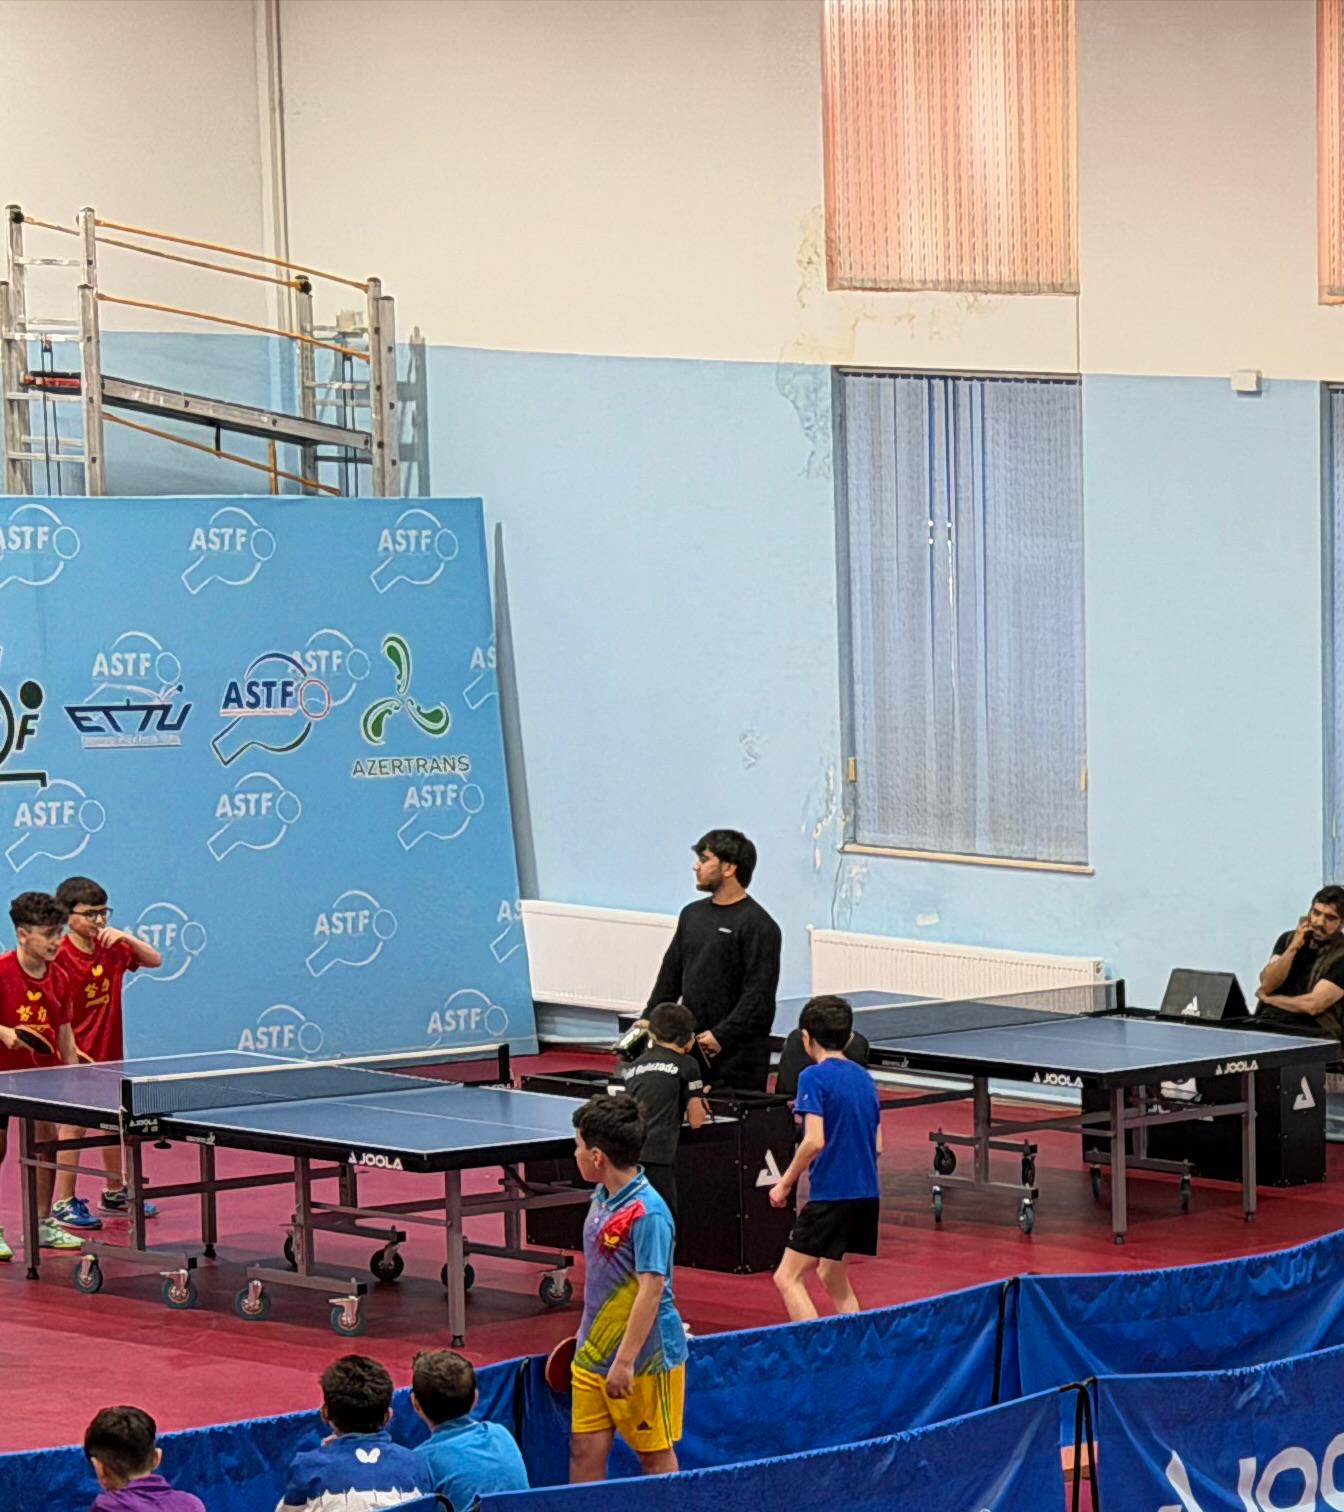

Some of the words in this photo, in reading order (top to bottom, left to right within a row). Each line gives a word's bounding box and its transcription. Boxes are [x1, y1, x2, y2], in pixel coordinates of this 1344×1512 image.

[190, 527, 248, 551] ASTF
[378, 528, 432, 551] ASTF
[92, 652, 151, 677] ASTF
[287, 650, 342, 674] ASTF
[222, 679, 295, 710] ASTF
[64, 703, 193, 733] ETTU
[352, 755, 471, 778] AZERTRANS
[215, 792, 273, 817] ASTF
[404, 784, 458, 808] ASTF
[14, 800, 76, 827] ASTF
[314, 910, 370, 935] ASTF
[427, 1008, 482, 1036] ASTF
[238, 1024, 295, 1051] ASTF
[1223, 1060, 1260, 1075] JOOLA
[1042, 1072, 1084, 1089] JOOLA
[358, 1152, 404, 1171] JOOLA
